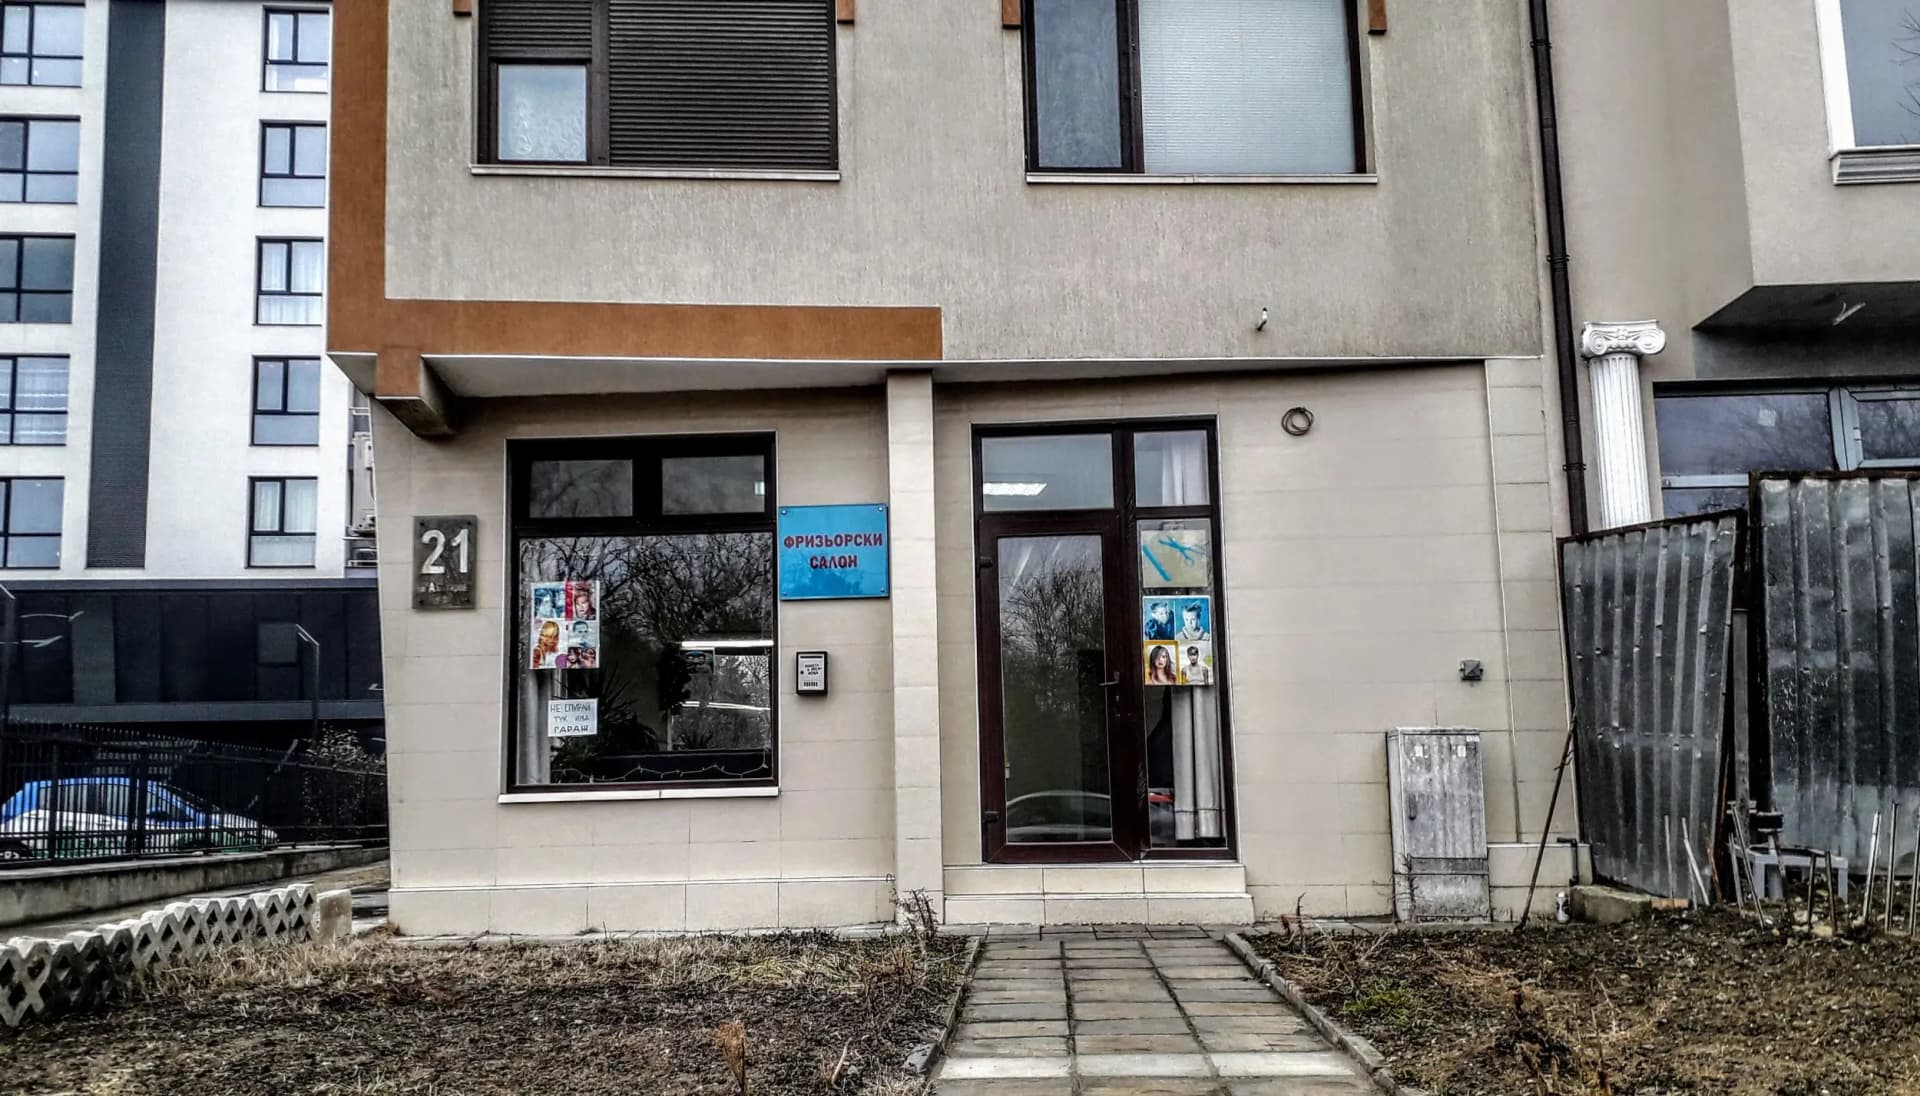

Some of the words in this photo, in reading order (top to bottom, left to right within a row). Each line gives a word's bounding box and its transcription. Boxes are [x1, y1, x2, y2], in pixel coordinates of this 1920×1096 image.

[783, 533, 883, 549] ФРИЗЬОРСКИ
[421, 528, 469, 574] 21
[809, 555, 858, 570] САЛОН
[550, 703, 561, 712] НЕ
